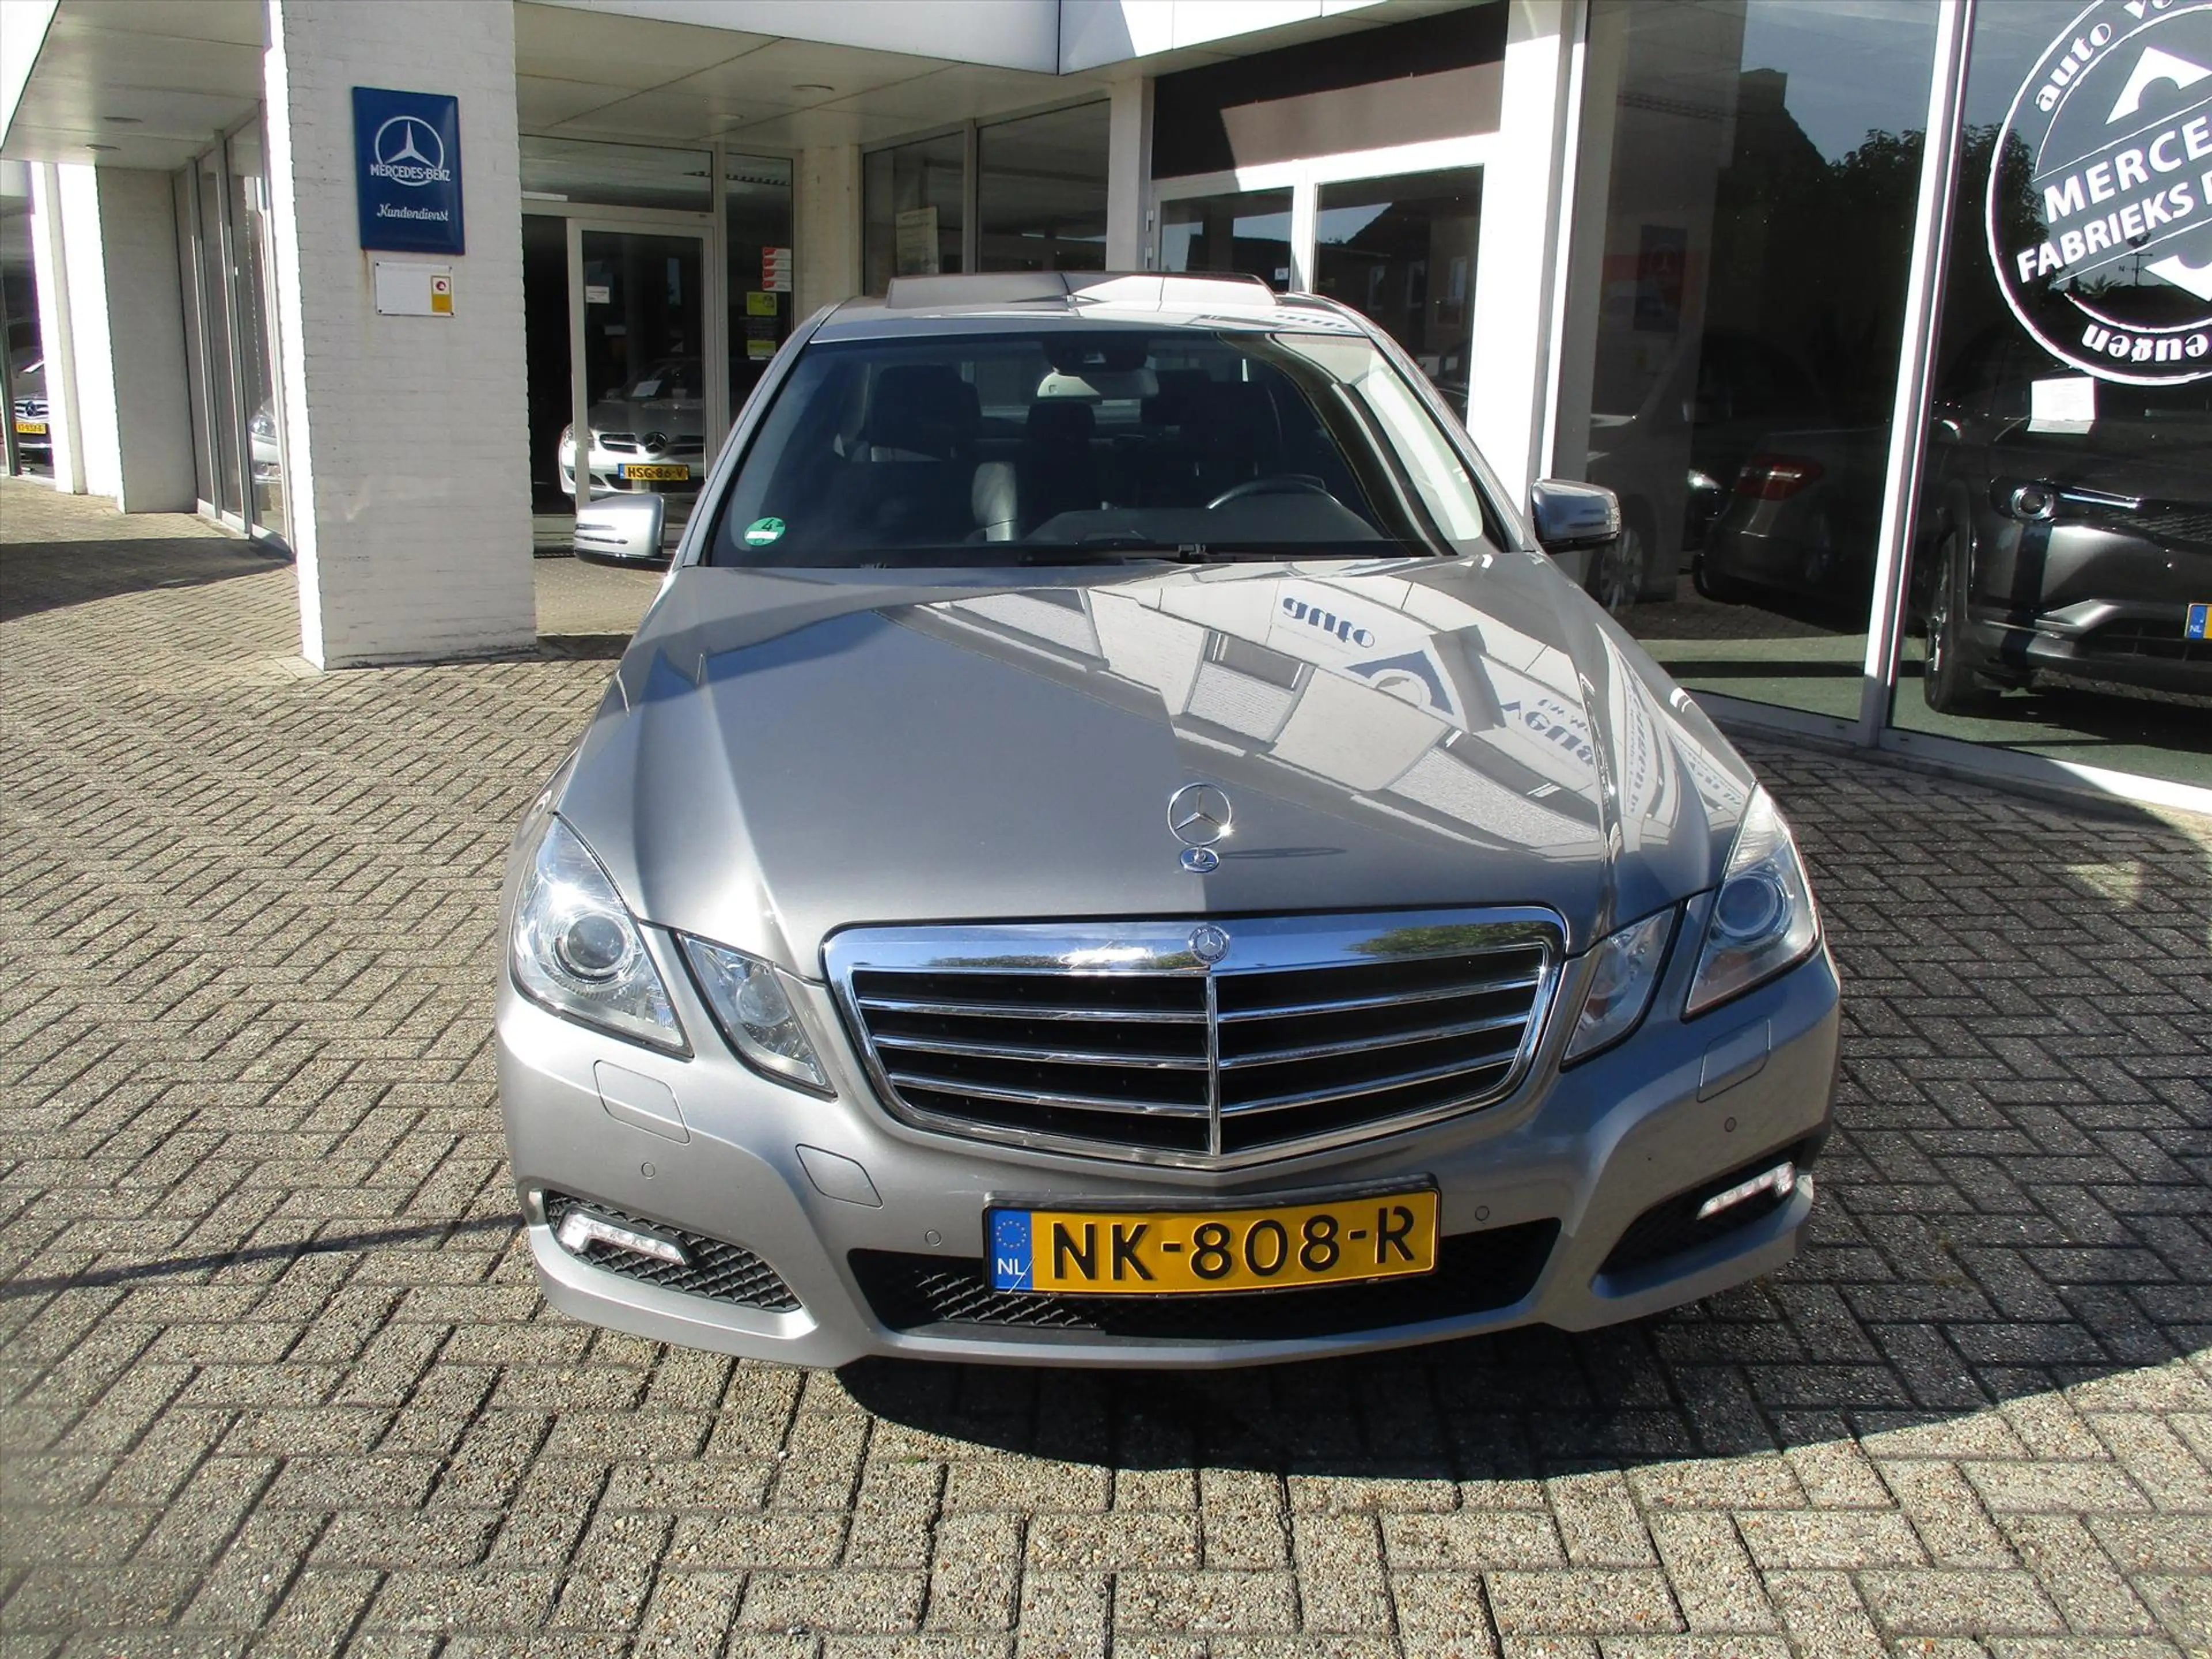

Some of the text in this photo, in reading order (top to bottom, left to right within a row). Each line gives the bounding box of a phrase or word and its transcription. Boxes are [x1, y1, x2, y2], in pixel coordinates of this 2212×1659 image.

[2035, 23, 2112, 112] auto
[370, 164, 451, 182] MERCEDES-BENZ
[376, 203, 449, 222] Kundendienst
[2017, 182, 2194, 283] FABRIEKS
[627, 466, 684, 479] HSG-86-V
[2190, 625, 2202, 633] NL
[997, 1205, 1416, 1281] NL NK-808-R
